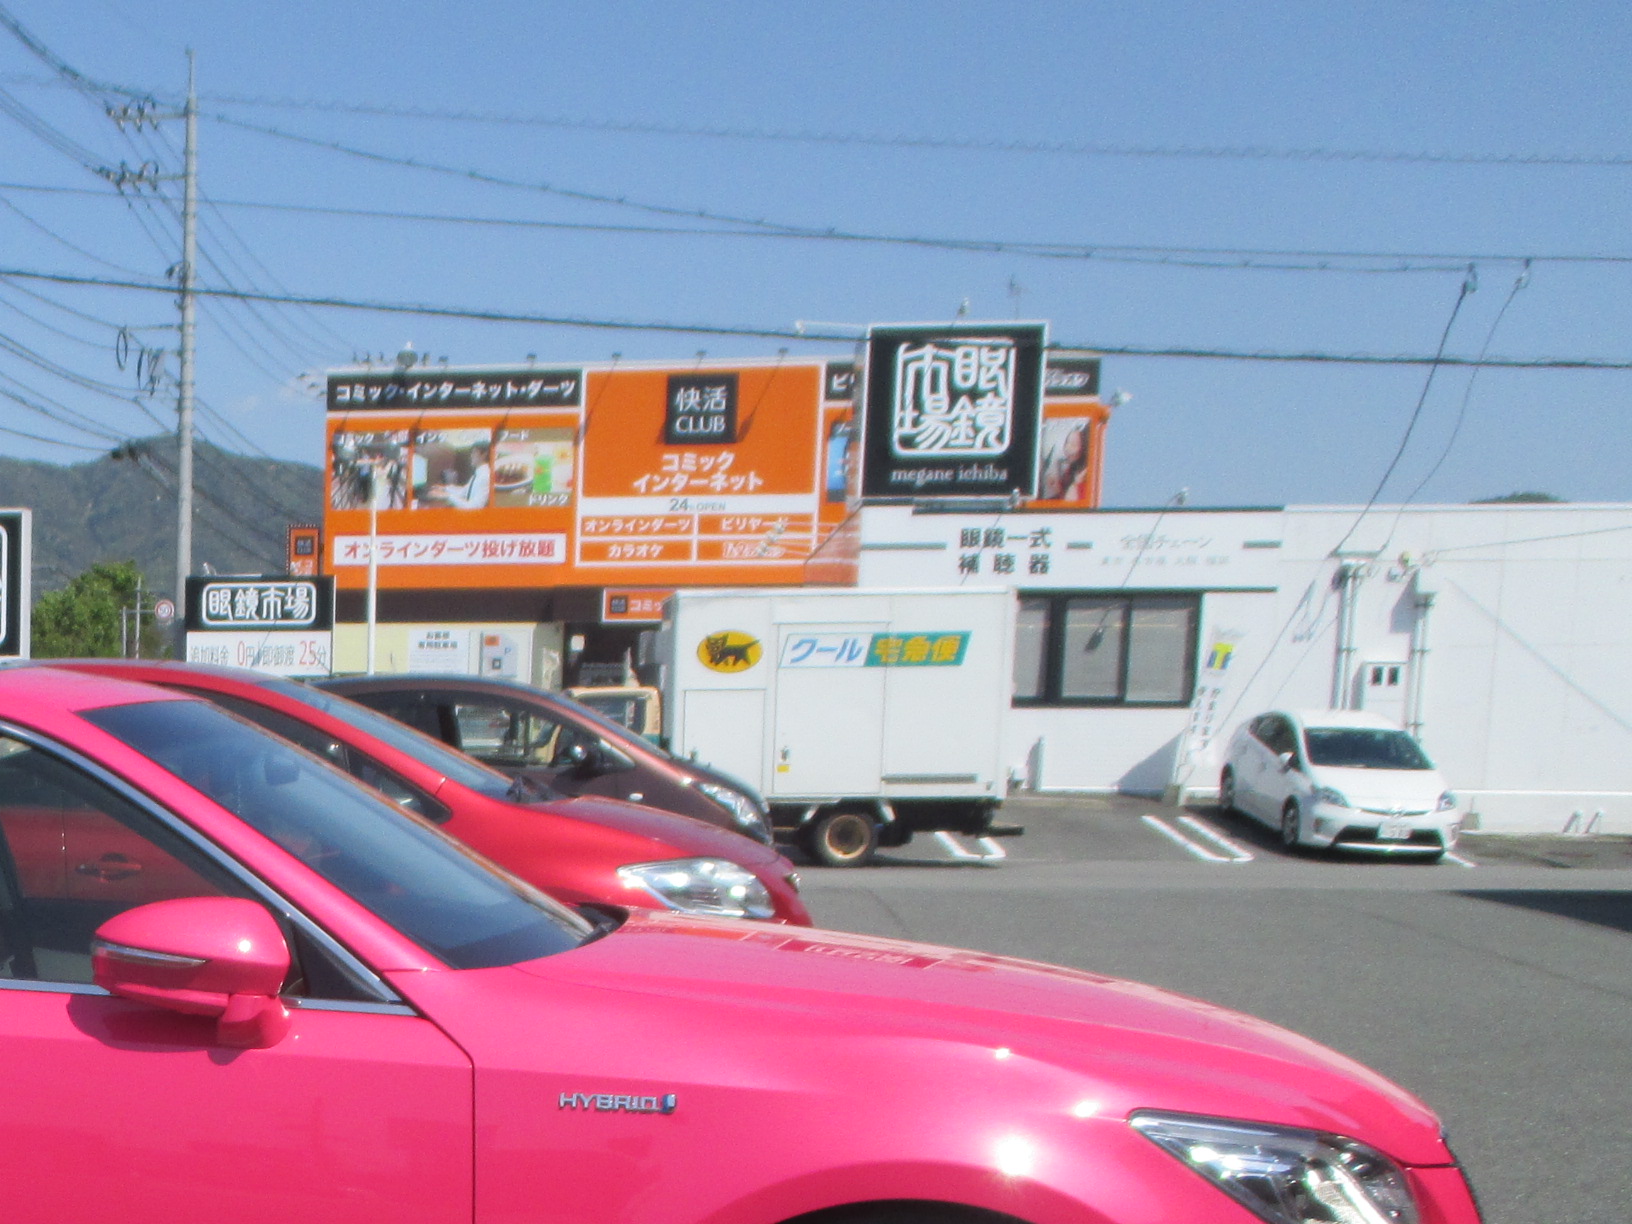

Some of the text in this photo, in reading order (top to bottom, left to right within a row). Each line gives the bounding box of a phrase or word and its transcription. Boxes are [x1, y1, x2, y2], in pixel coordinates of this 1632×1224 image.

[675, 386, 729, 412] 快活
[675, 415, 726, 434] CLUB
[661, 451, 736, 472] コミック
[633, 471, 764, 493] インターネット
[890, 462, 1008, 488] megane ichiba
[669, 497, 689, 512] 24
[584, 517, 691, 533] オンラインダーツ
[608, 542, 665, 559] カラオケ
[208, 586, 311, 621] 眼鏡市場
[790, 637, 865, 664] クール
[874, 634, 962, 663] 宅急便
[559, 1092, 659, 1111] HYBRID
